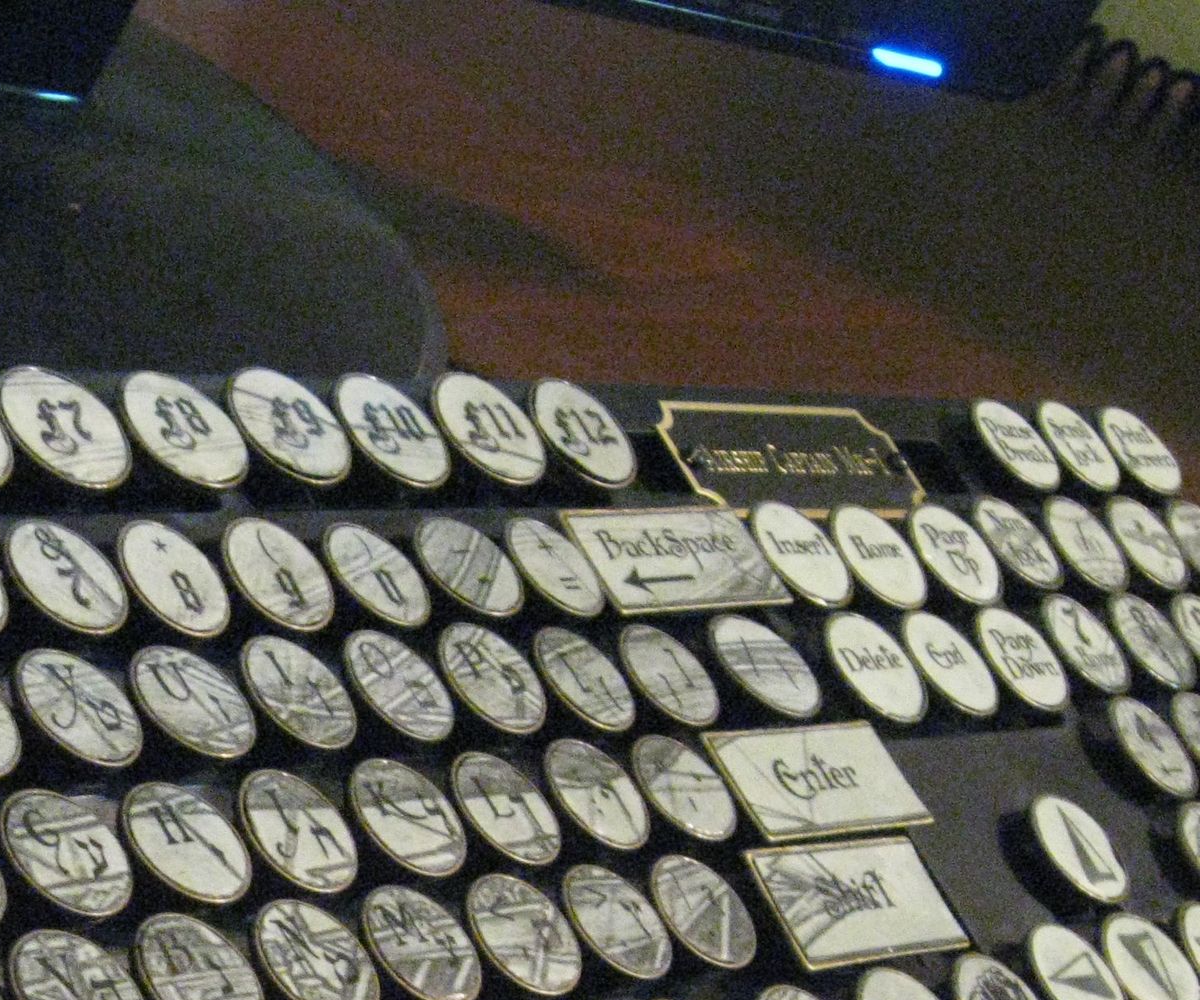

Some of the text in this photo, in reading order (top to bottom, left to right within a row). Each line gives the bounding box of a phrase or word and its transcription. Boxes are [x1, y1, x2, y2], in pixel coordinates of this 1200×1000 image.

[593, 527, 737, 572] BackSpace
[766, 528, 837, 557] Insert
[848, 534, 904, 561] Home
[56, 565, 91, 609] 7
[273, 565, 308, 608] 9
[949, 551, 983, 585] Up
[170, 569, 205, 614] 8
[841, 642, 904, 674] Delete
[40, 662, 80, 730] Y
[147, 660, 192, 702] U
[469, 774, 515, 818] L
[771, 752, 861, 801] Enter
[149, 801, 196, 846] H
[264, 786, 300, 859] J
[813, 867, 897, 922] Shift
